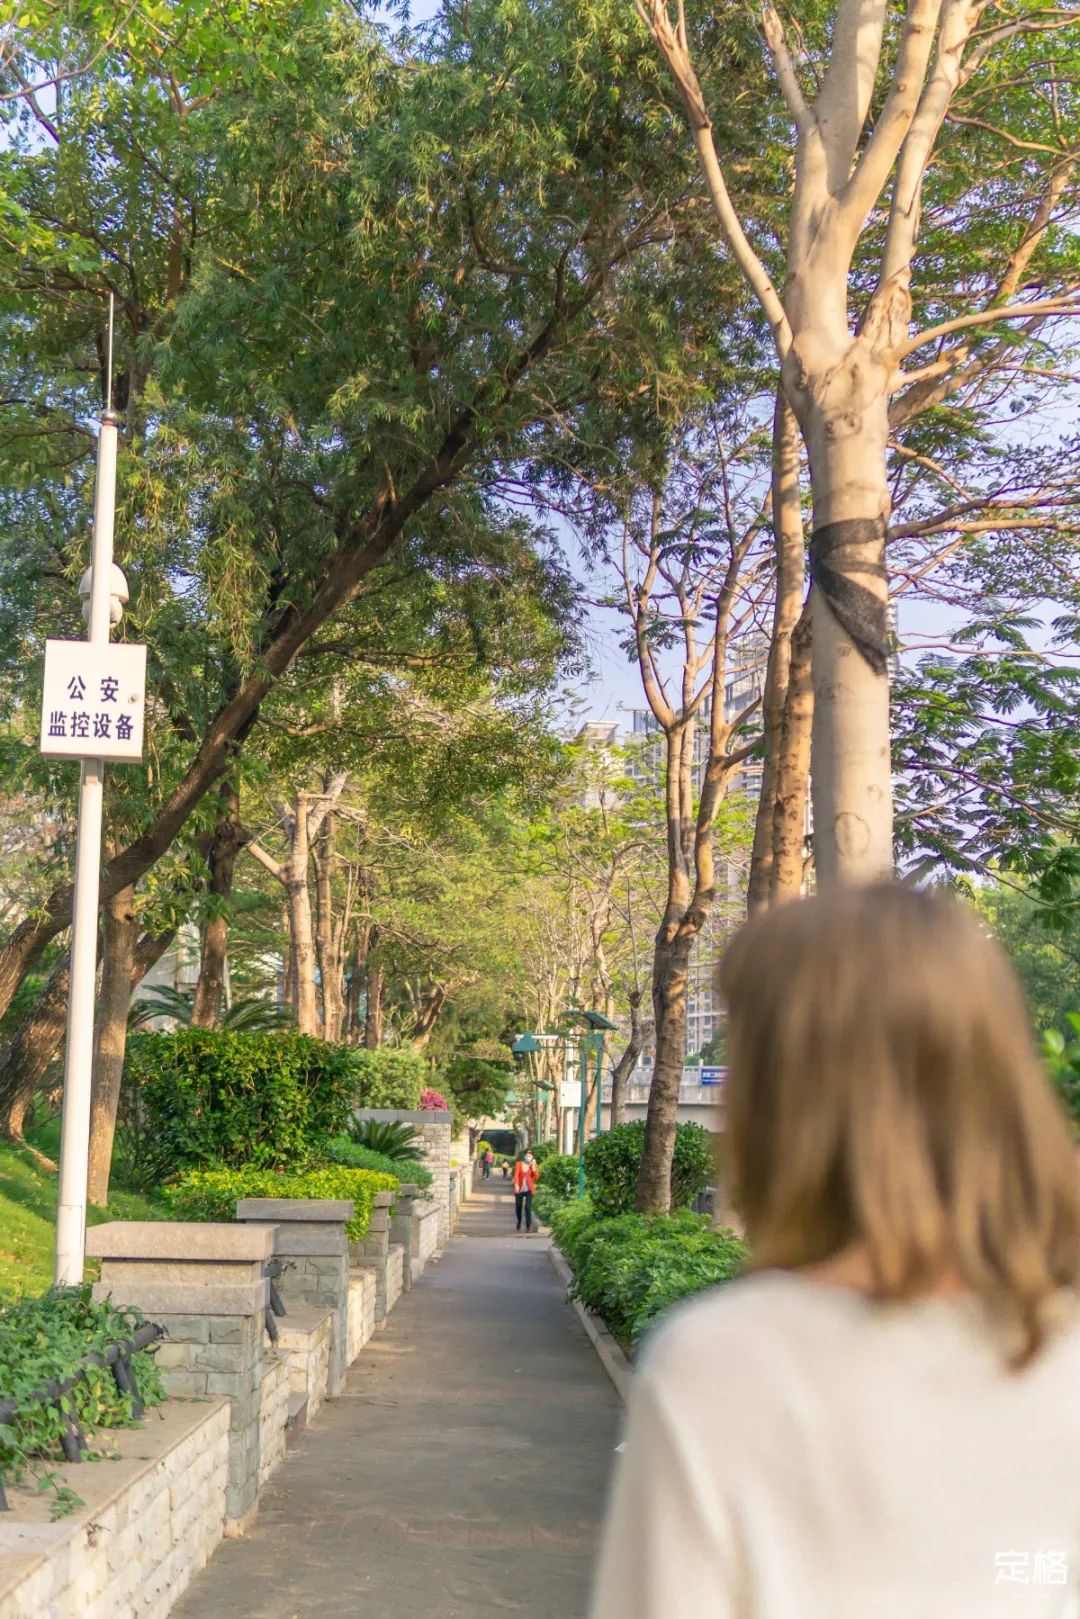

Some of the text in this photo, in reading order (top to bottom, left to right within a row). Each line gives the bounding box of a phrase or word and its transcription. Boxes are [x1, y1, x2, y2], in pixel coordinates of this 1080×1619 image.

[67, 675, 119, 702] 公安
[47, 711, 134, 740] 监控设备
